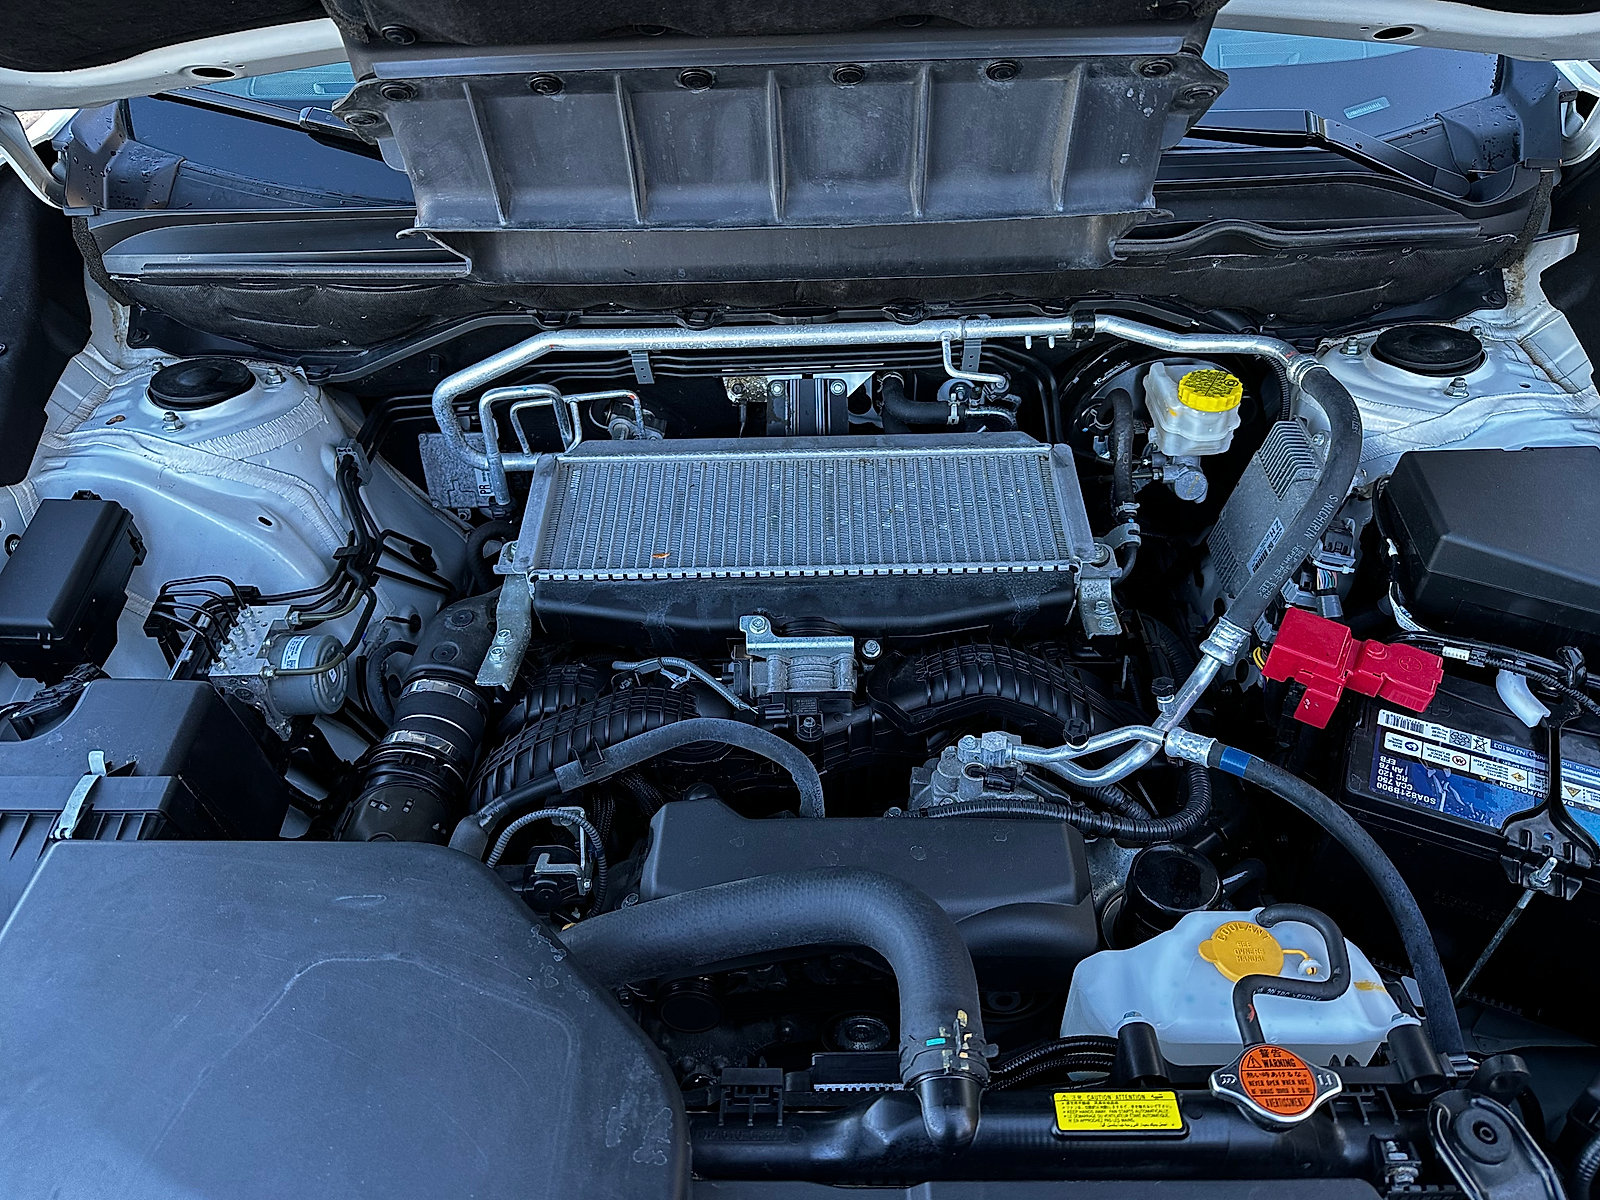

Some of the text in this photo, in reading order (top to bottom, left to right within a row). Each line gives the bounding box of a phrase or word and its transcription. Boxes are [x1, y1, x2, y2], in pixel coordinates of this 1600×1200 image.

[1380, 755, 1396, 766] EFB
[1377, 768, 1409, 782] RC 120
[1391, 765, 1404, 774] Ah
[1377, 775, 1413, 791] CCA 750
[1216, 922, 1273, 942] COOLANT
[1262, 1058, 1297, 1068] WARNING
